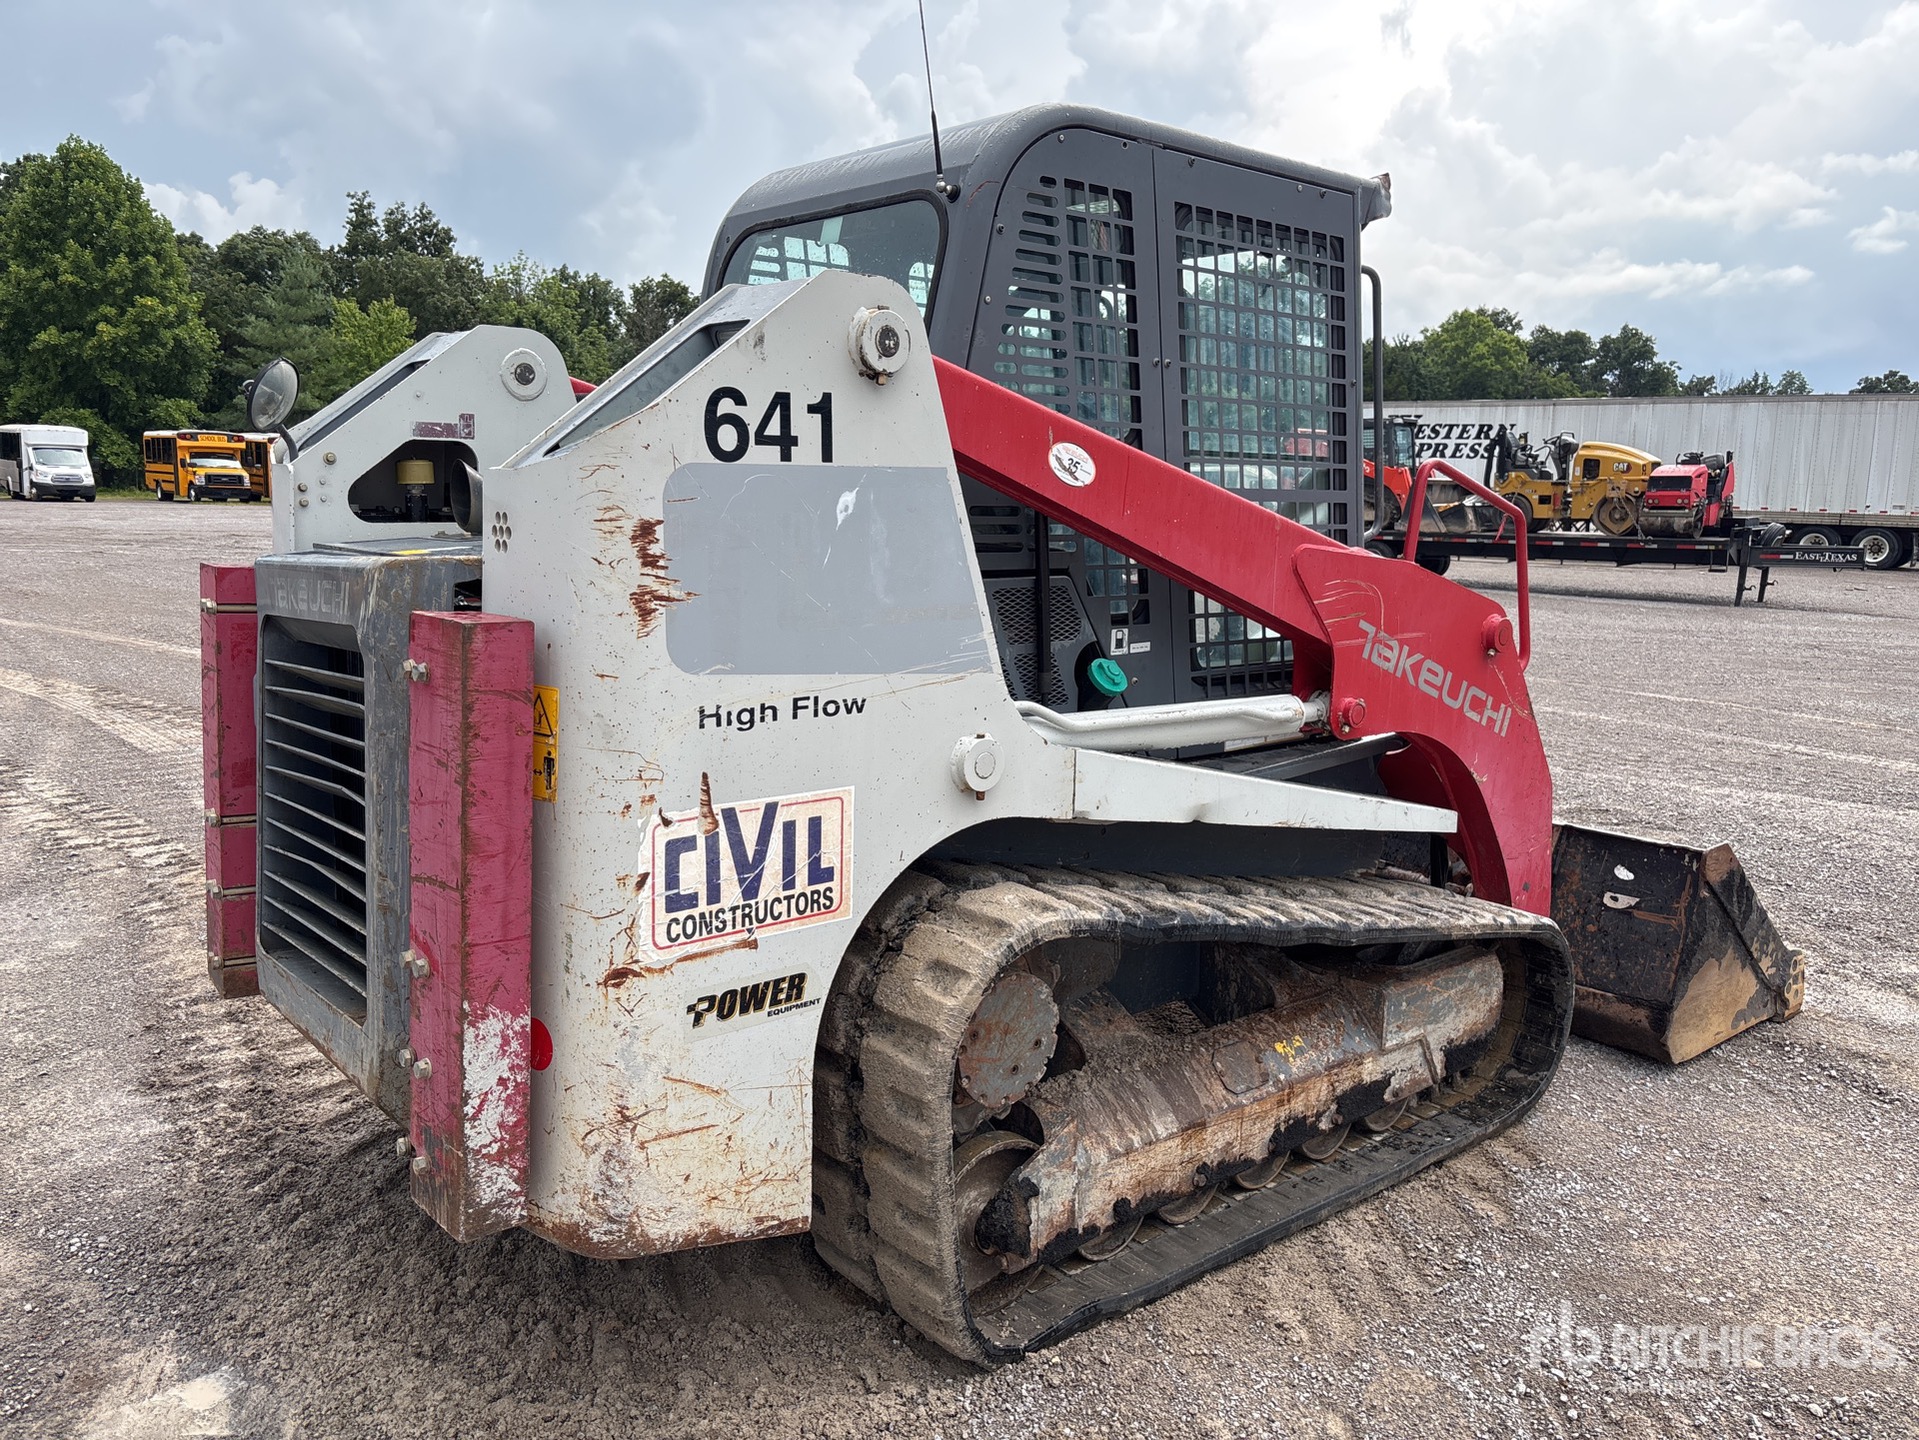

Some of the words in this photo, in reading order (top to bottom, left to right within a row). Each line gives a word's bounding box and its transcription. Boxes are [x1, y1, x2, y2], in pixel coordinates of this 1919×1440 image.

[704, 386, 833, 463] 641
[1388, 414, 1516, 440] ESTERN
[1613, 462, 1628, 471] CAT
[1795, 551, 1821, 560] EAST
[1823, 551, 1858, 561] TEXAS
[698, 702, 778, 732] High
[792, 695, 867, 720] Flow
[664, 801, 835, 914] CIVIL
[666, 886, 834, 943] CONSTRUCTORS
[687, 972, 809, 1029] POWER
[767, 998, 821, 1017] EQUIPMENT
